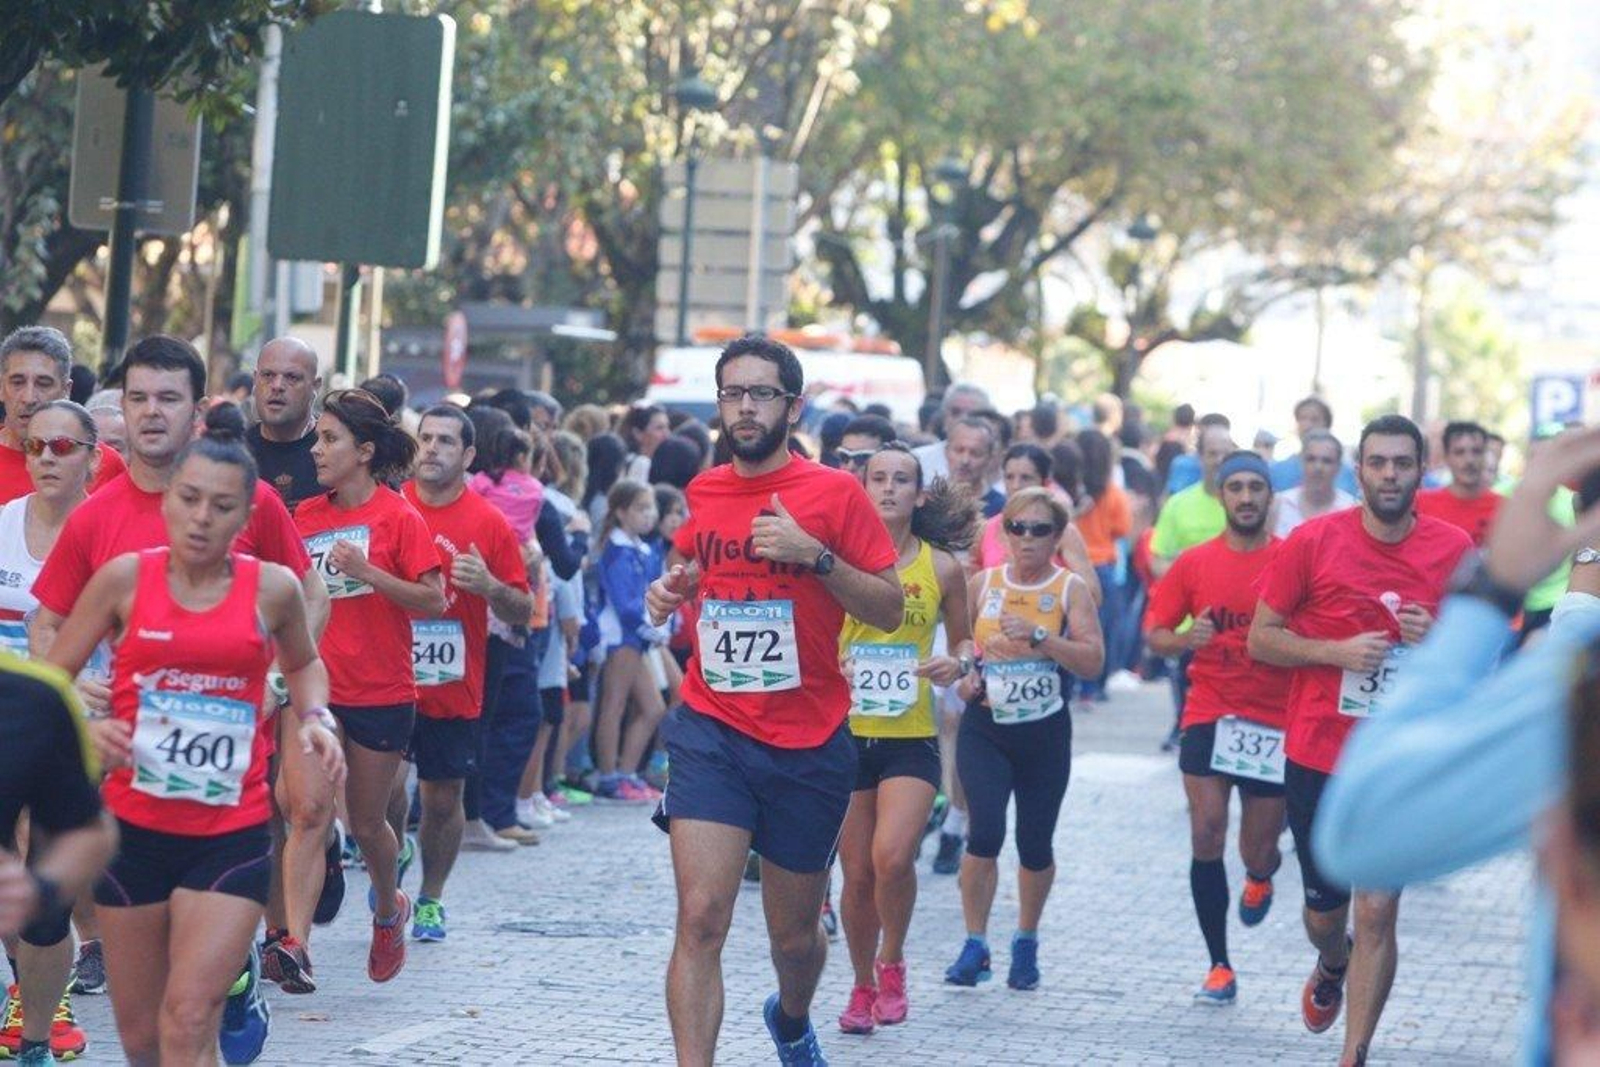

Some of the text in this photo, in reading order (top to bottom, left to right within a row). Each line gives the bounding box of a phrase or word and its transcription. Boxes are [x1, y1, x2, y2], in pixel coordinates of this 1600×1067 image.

[1537, 380, 1577, 424] P
[412, 641, 455, 665] 540
[714, 630, 783, 663] 472
[166, 668, 248, 692] Seguros
[1004, 676, 1053, 704] 268
[156, 728, 235, 772] 460
[1228, 729, 1280, 759] 337
